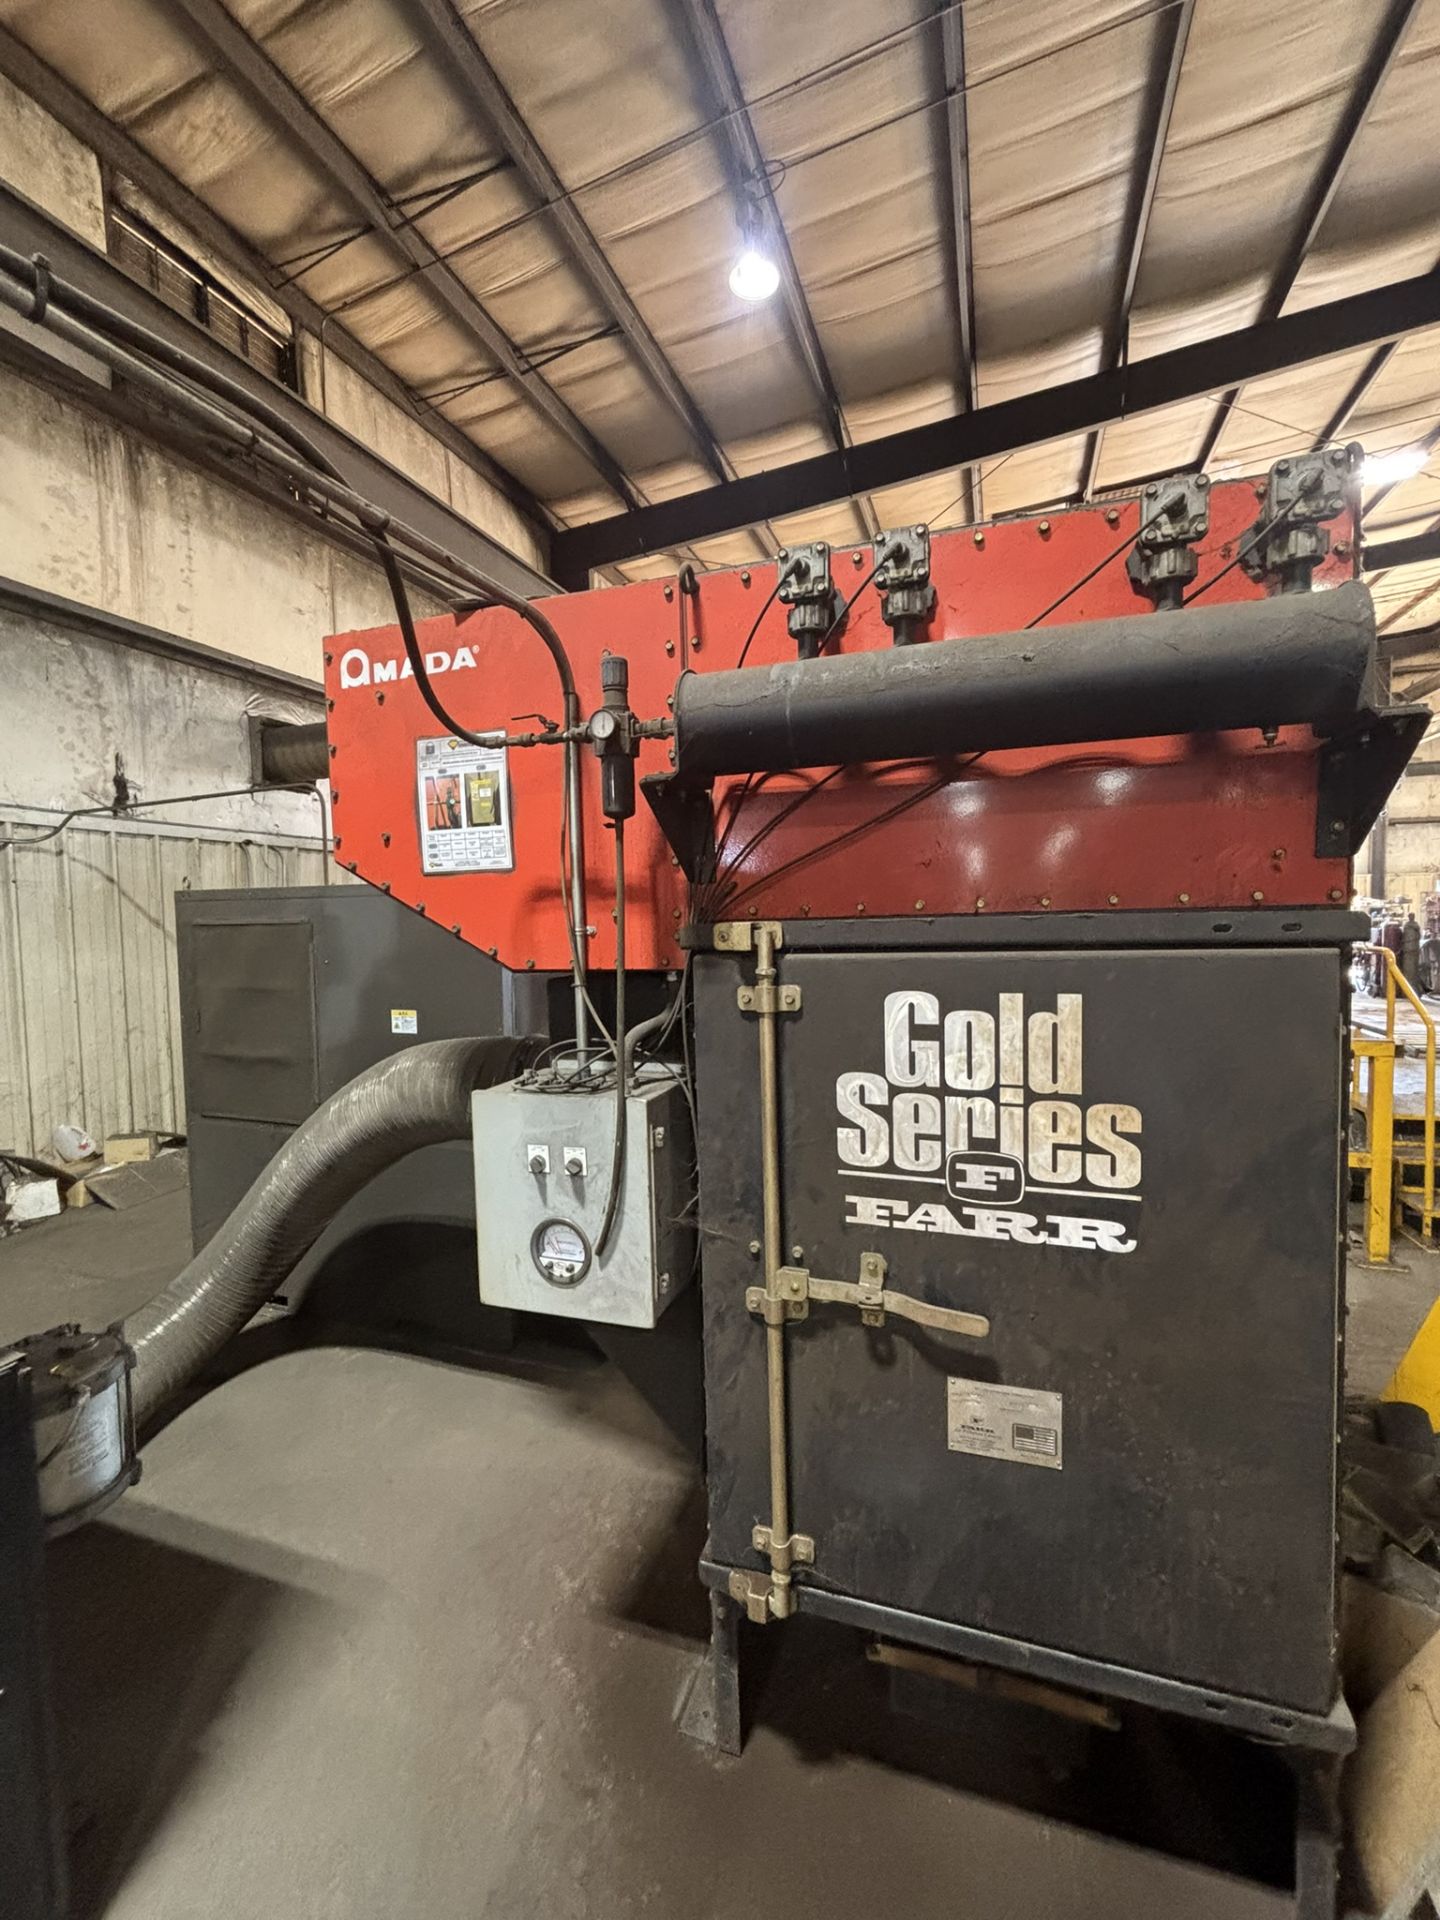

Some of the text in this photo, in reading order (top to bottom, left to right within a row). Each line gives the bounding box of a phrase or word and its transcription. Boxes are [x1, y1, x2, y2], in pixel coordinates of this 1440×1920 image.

[884, 990, 1083, 1095] Gold
[836, 1071, 1142, 1188] Series
[955, 1162, 1015, 1191] F
[845, 1194, 1137, 1253] FARR
